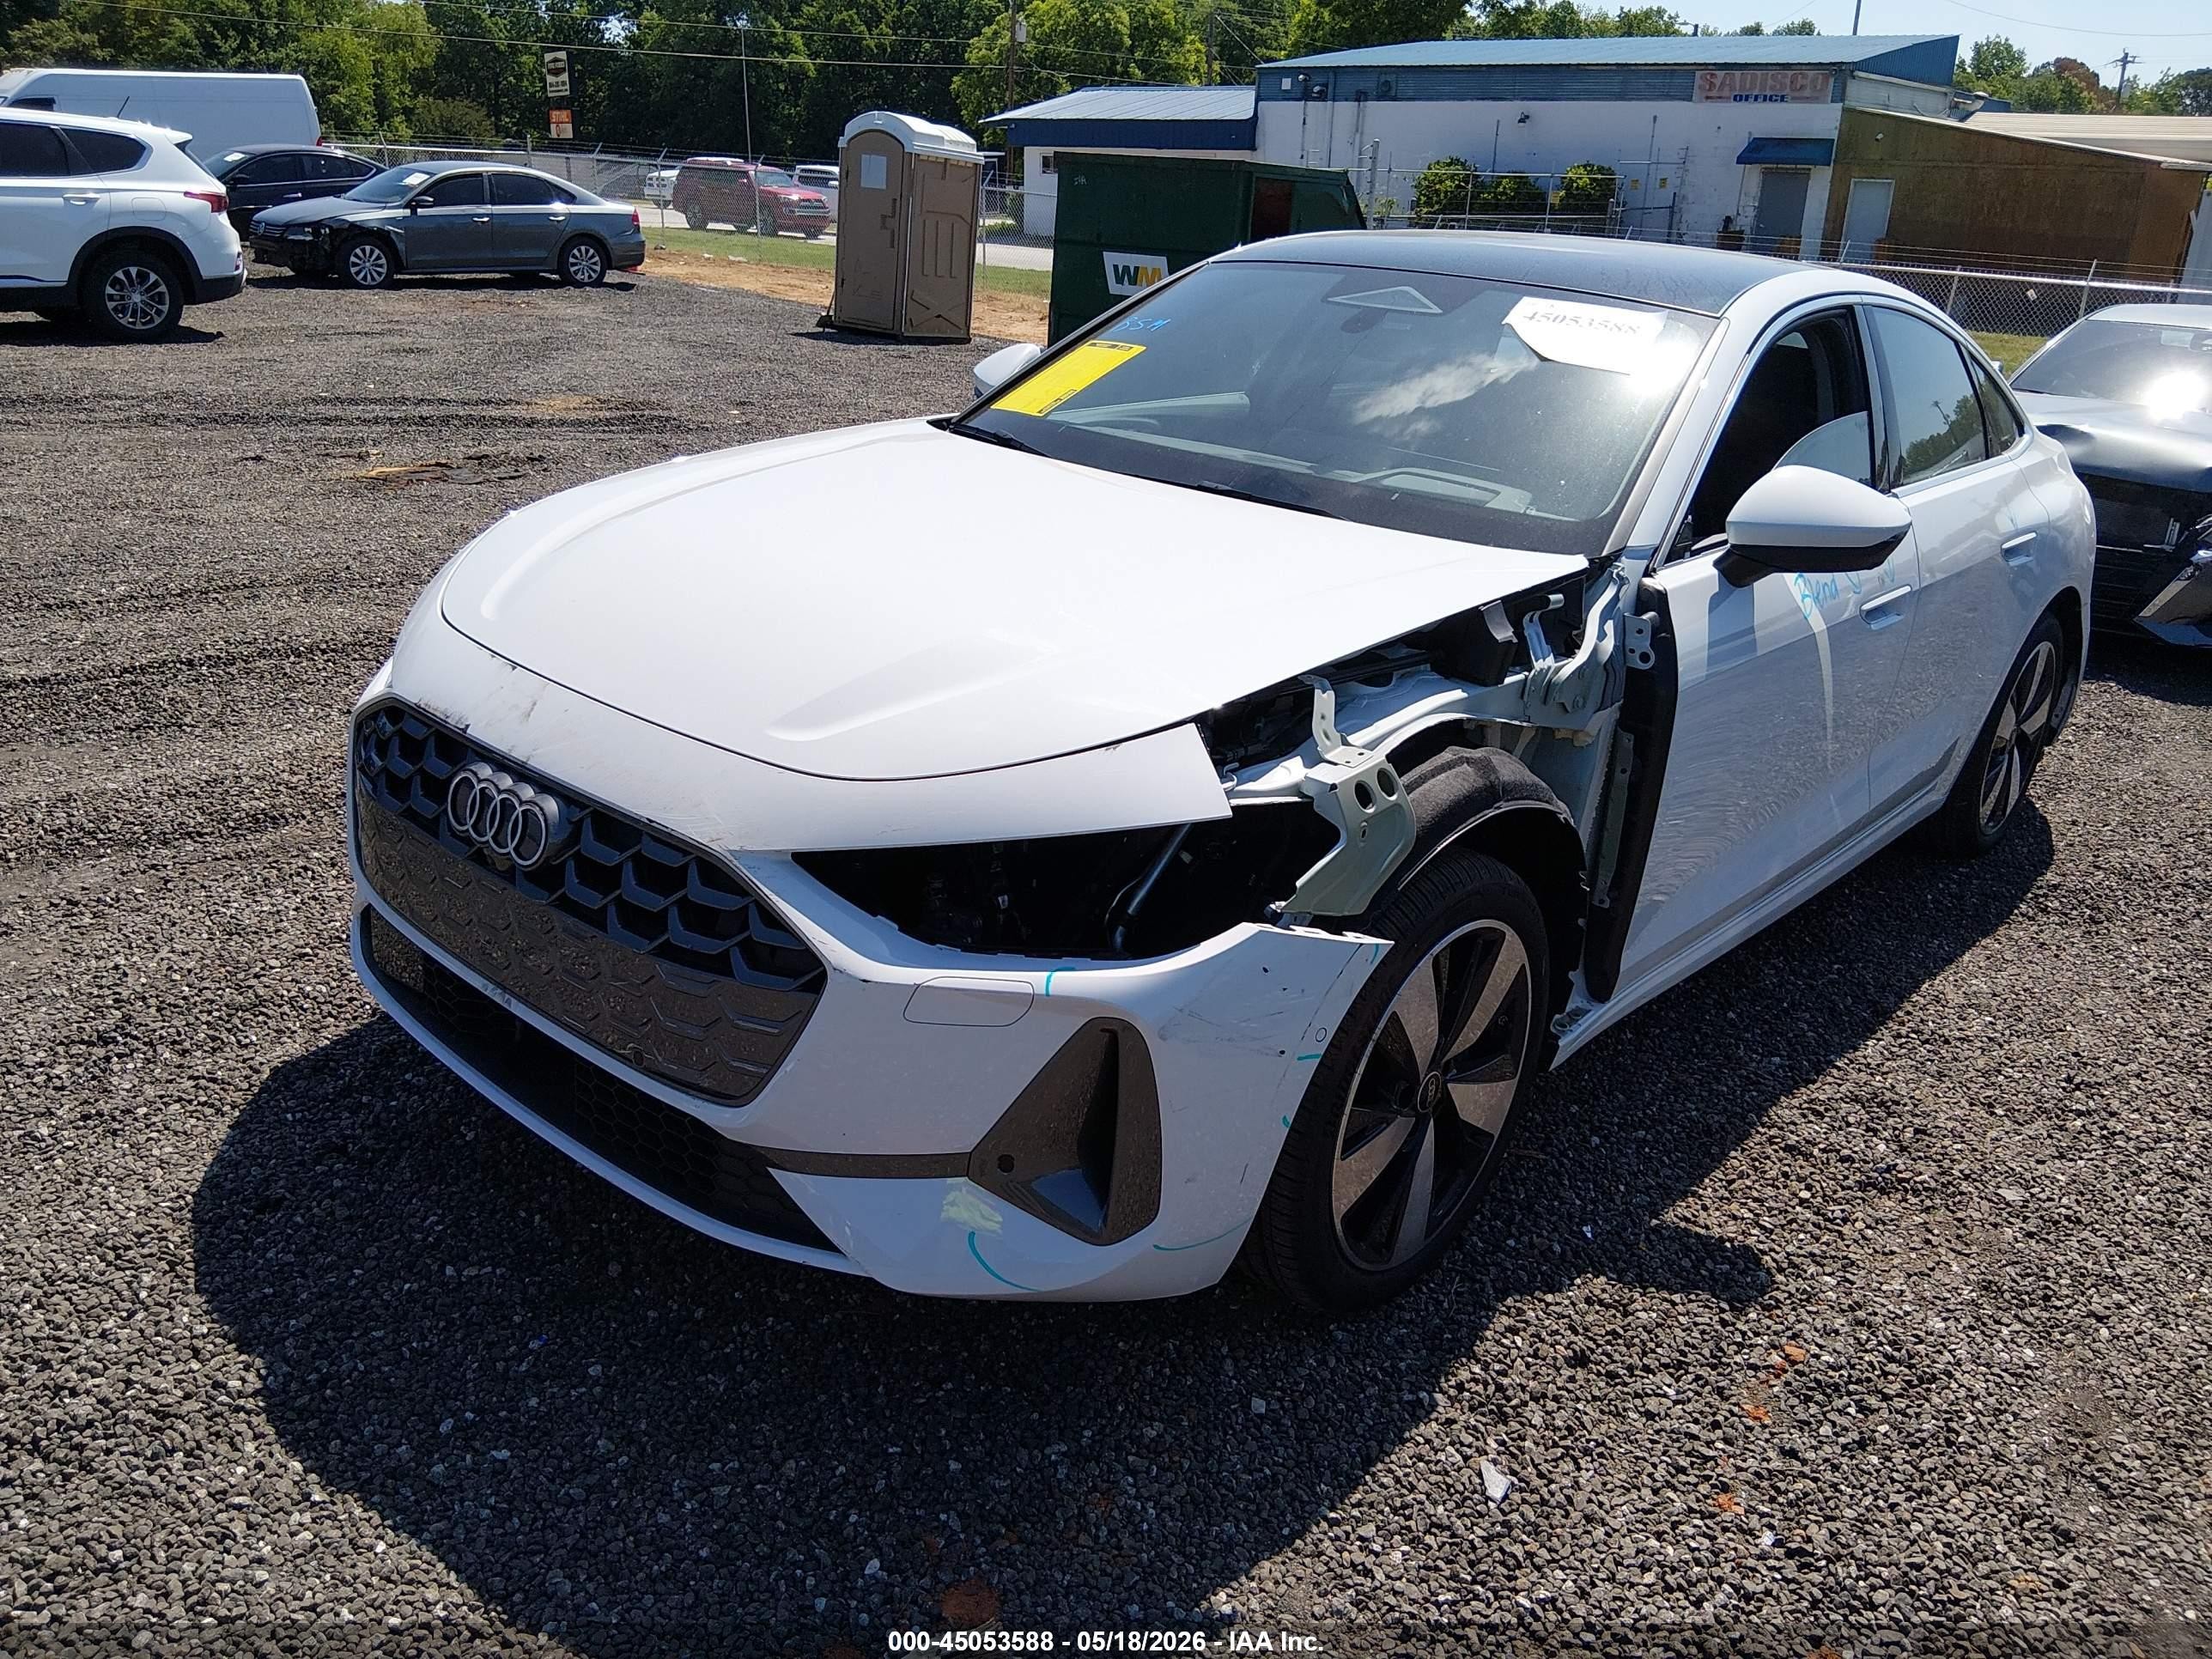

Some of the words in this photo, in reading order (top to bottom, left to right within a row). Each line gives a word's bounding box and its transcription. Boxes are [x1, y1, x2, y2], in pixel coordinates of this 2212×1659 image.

[1698, 71, 1831, 92] SADISCO
[1732, 93, 1789, 103] OFFICE
[1113, 264, 1163, 287] WM
